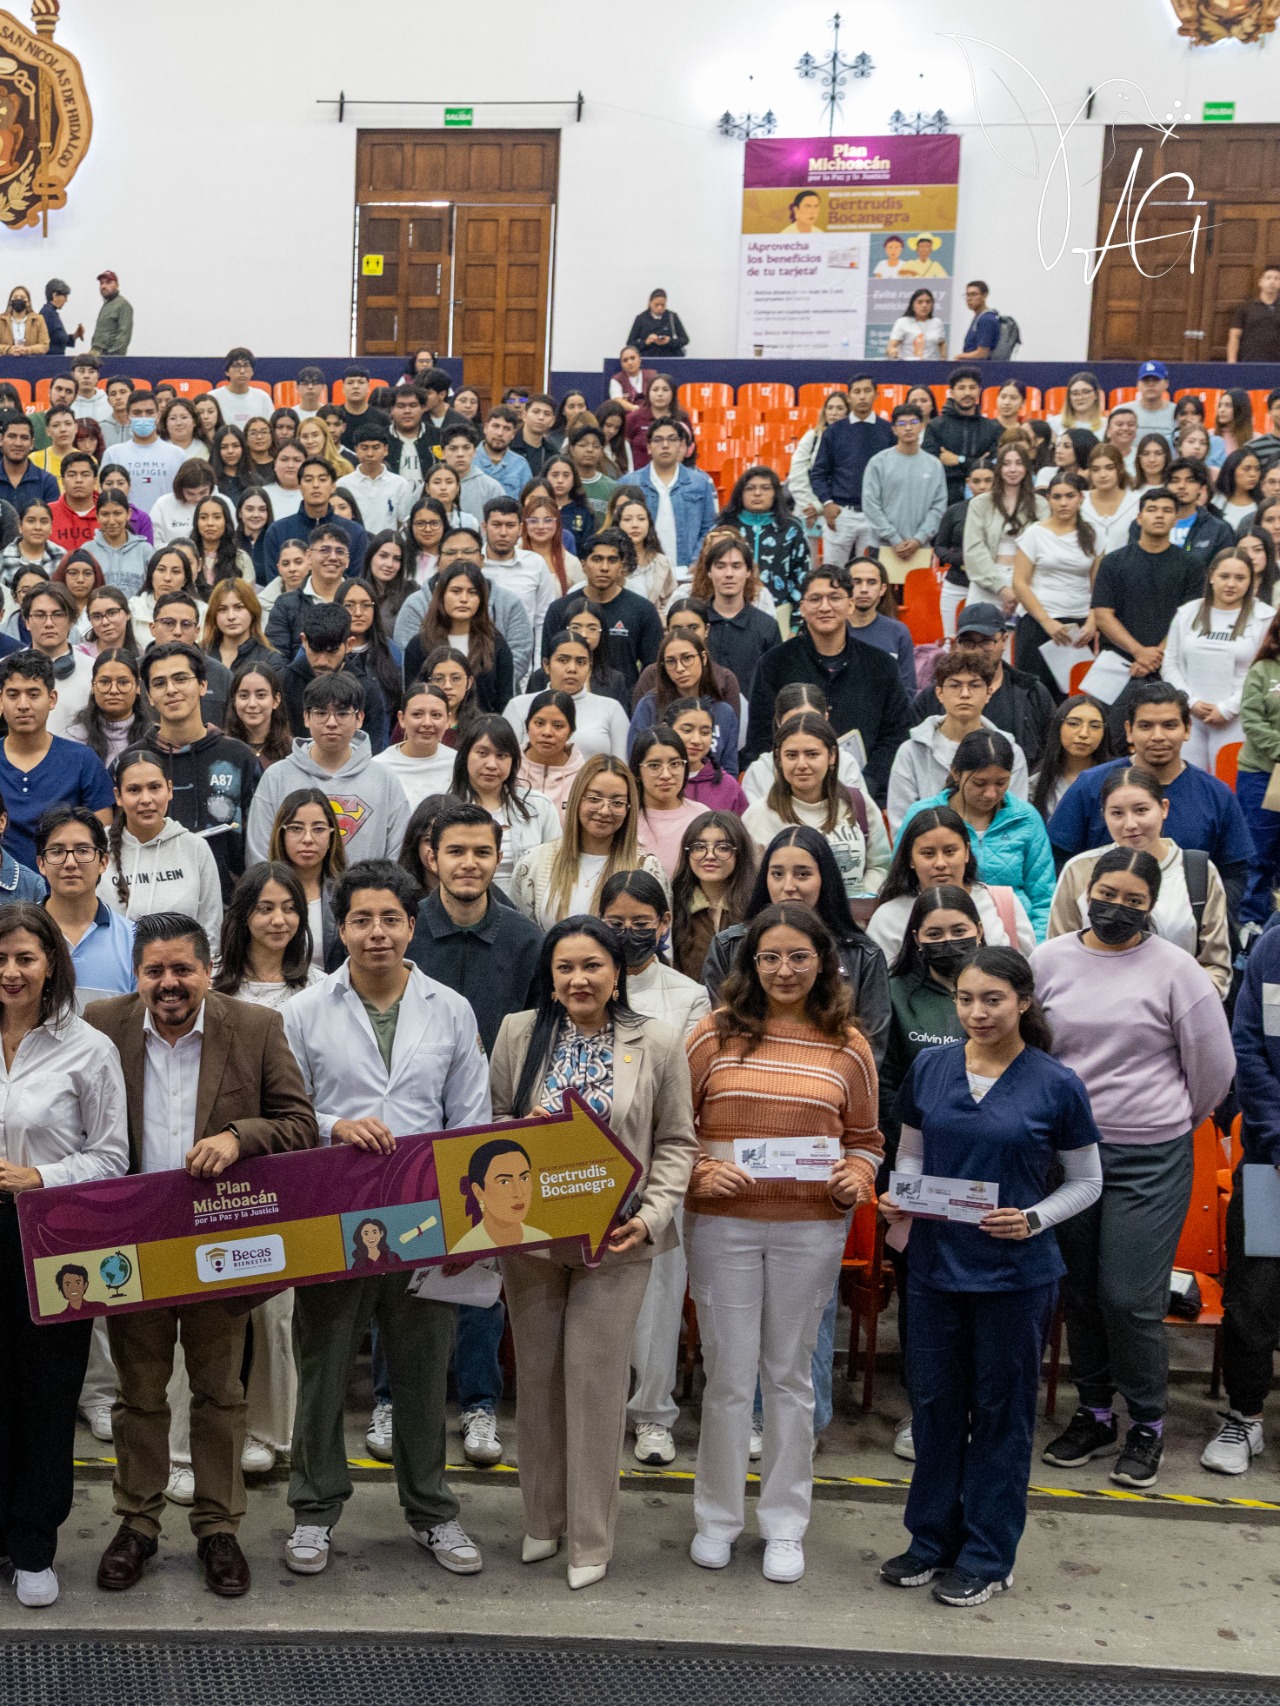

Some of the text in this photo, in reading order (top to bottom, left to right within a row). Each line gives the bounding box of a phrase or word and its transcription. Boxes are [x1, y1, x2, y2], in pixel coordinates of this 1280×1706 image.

[1, 25, 25, 48] SAN
[24, 42, 71, 86] NICOLAS
[63, 86, 75, 108] DE
[57, 107, 82, 168] HIDALGO
[832, 143, 867, 158] Plan
[808, 155, 891, 171] Michoacán
[827, 196, 903, 211] Gertrudis
[827, 211, 910, 227] Bocanegra
[747, 254, 822, 264] los beneficios
[747, 267, 760, 276] de
[763, 267, 775, 276] tu
[129, 469, 168, 477] ILFIGER
[57, 529, 94, 541] HUG
[209, 773, 233, 787] A87
[908, 1031, 942, 1045] Calvin
[539, 1164, 608, 1185] Gertrudis
[215, 1180, 251, 1196] Plan
[541, 1177, 616, 1198] Bocanegra
[193, 1189, 279, 1214] Michoacán
[194, 1217, 209, 1227] por
[250, 1206, 279, 1217] Justicia
[231, 1247, 272, 1262] Becas
[233, 1257, 273, 1268] BIENESTAR
